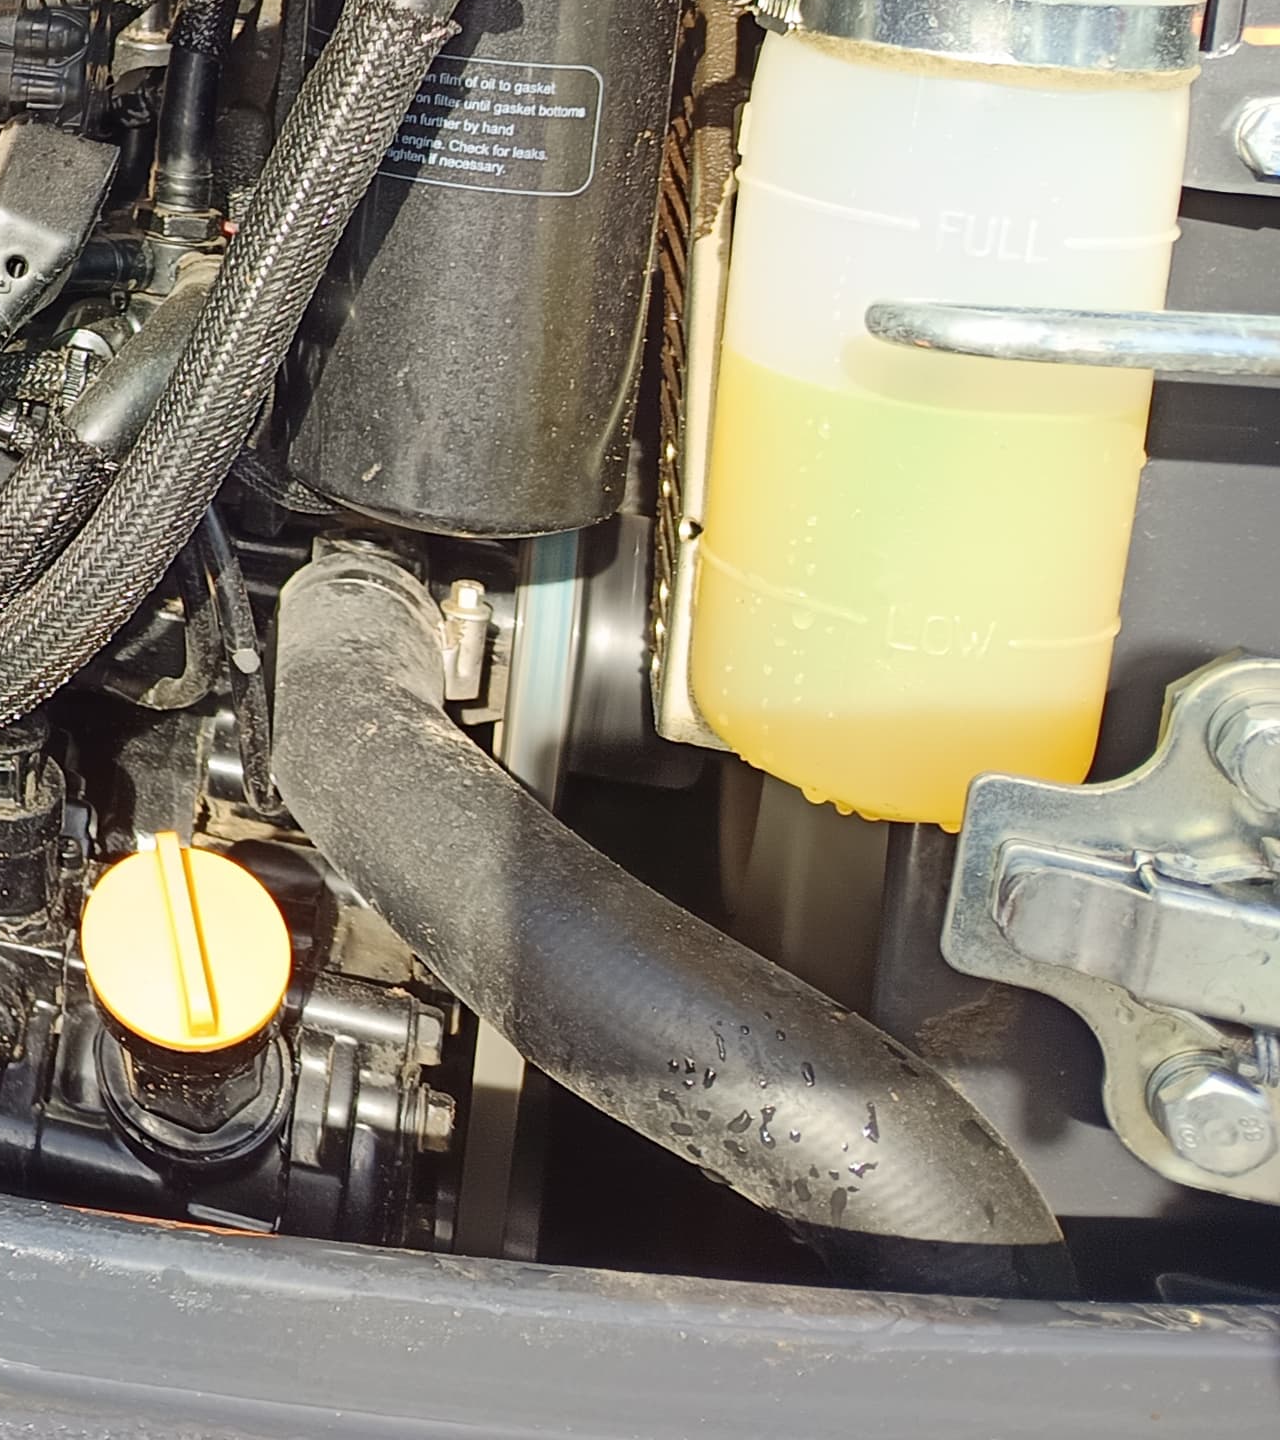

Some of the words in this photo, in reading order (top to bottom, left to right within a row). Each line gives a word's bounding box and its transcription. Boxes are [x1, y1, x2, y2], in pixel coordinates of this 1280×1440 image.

[440, 72, 461, 86] film
[464, 75, 477, 89] of
[480, 77, 495, 91] oil
[498, 80, 511, 92] to
[514, 81, 556, 96] gasket
[434, 93, 461, 109] filter
[464, 97, 491, 112] until
[493, 101, 536, 117] gasket
[538, 105, 586, 119] bottoms
[419, 112, 461, 130] further
[463, 117, 481, 135] by
[482, 122, 515, 137] hand
[401, 134, 445, 151] engine.
[448, 138, 490, 157] Check
[492, 143, 510, 158] for
[512, 146, 549, 161] leaks.
[439, 154, 507, 175] necessary.
[935, 212, 1048, 263] FULL
[886, 603, 996, 659] LOW
